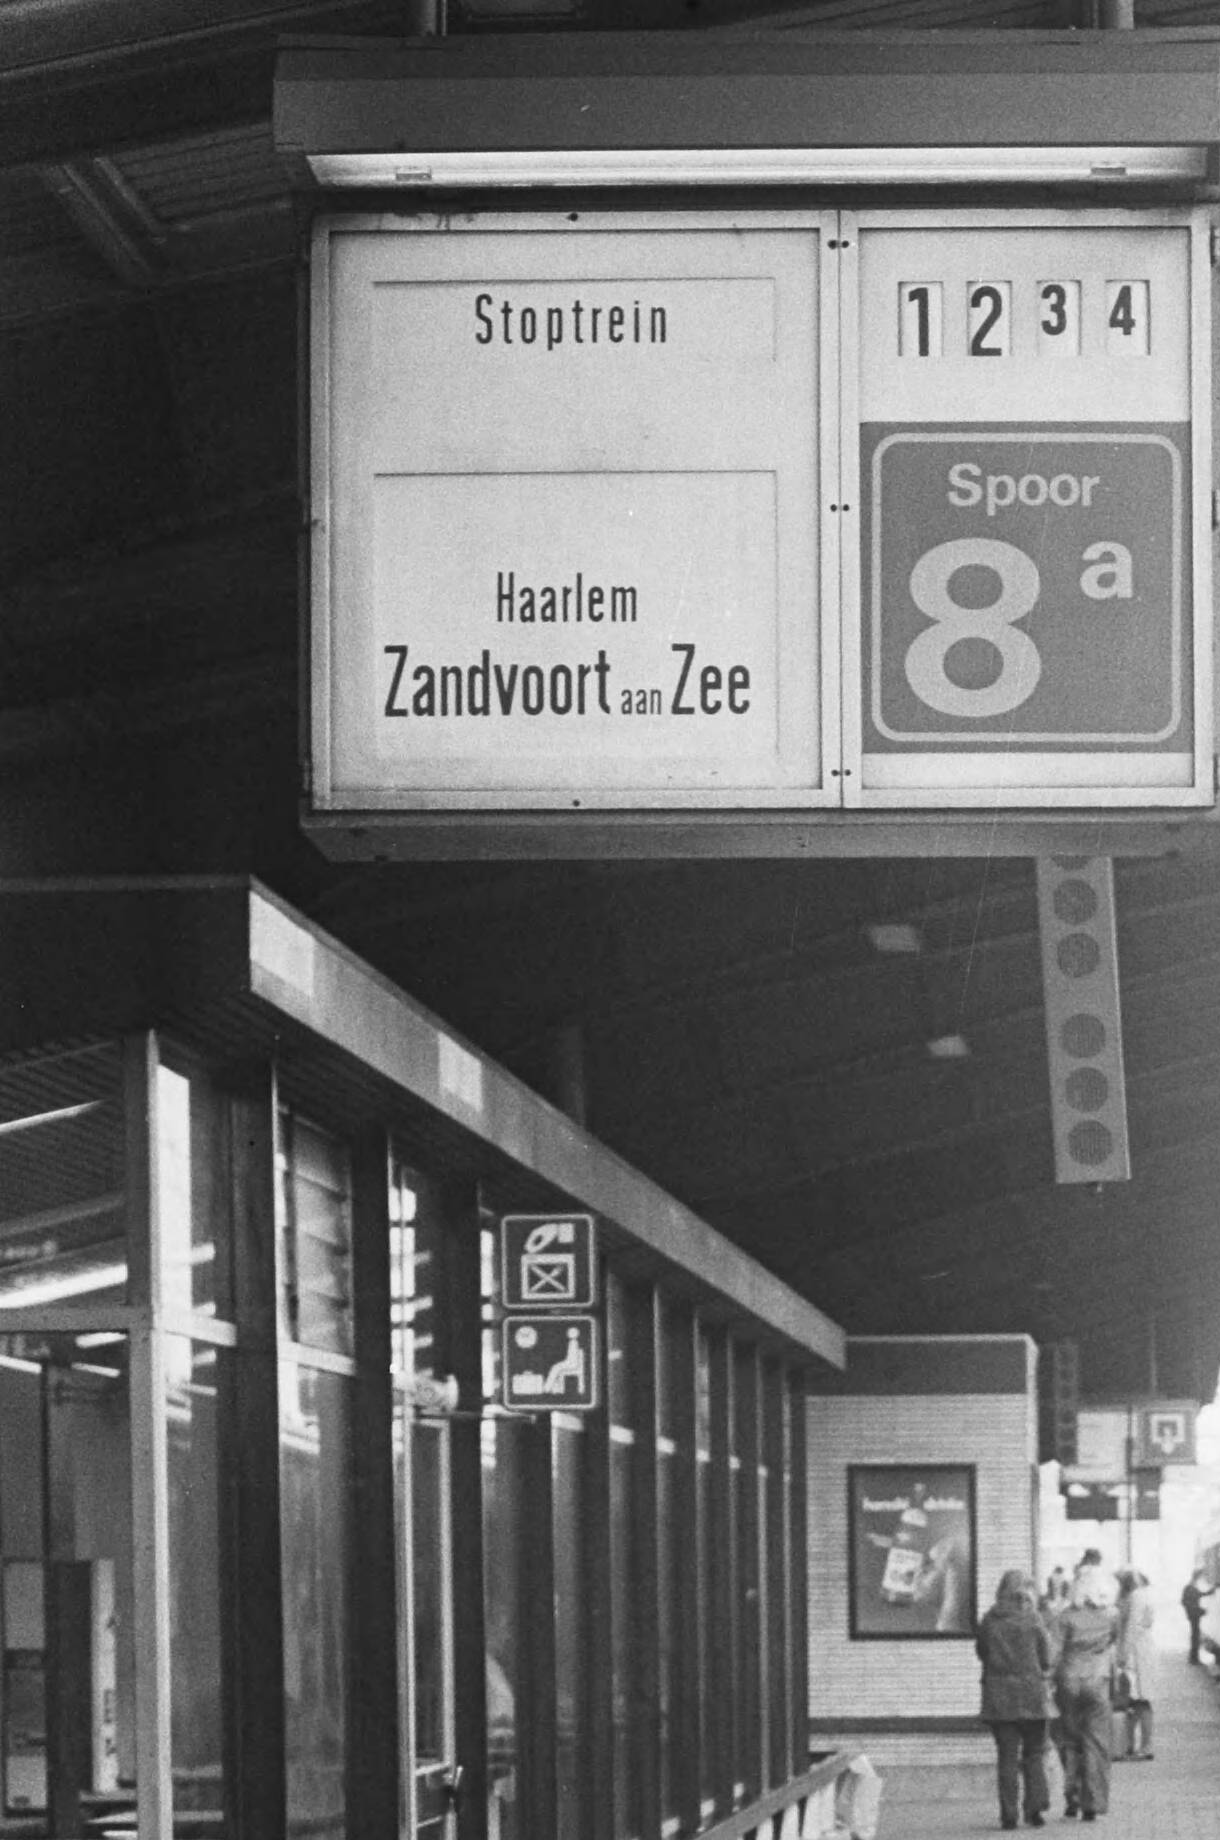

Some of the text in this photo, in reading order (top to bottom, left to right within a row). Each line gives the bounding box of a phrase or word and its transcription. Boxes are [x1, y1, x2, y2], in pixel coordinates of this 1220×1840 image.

[476, 294, 668, 351] Stoptrein
[948, 463, 1100, 516] Spoor
[497, 572, 637, 624] Haarlem
[905, 538, 1134, 718] 8 a
[384, 643, 750, 717] Zandvoort aan Zee
